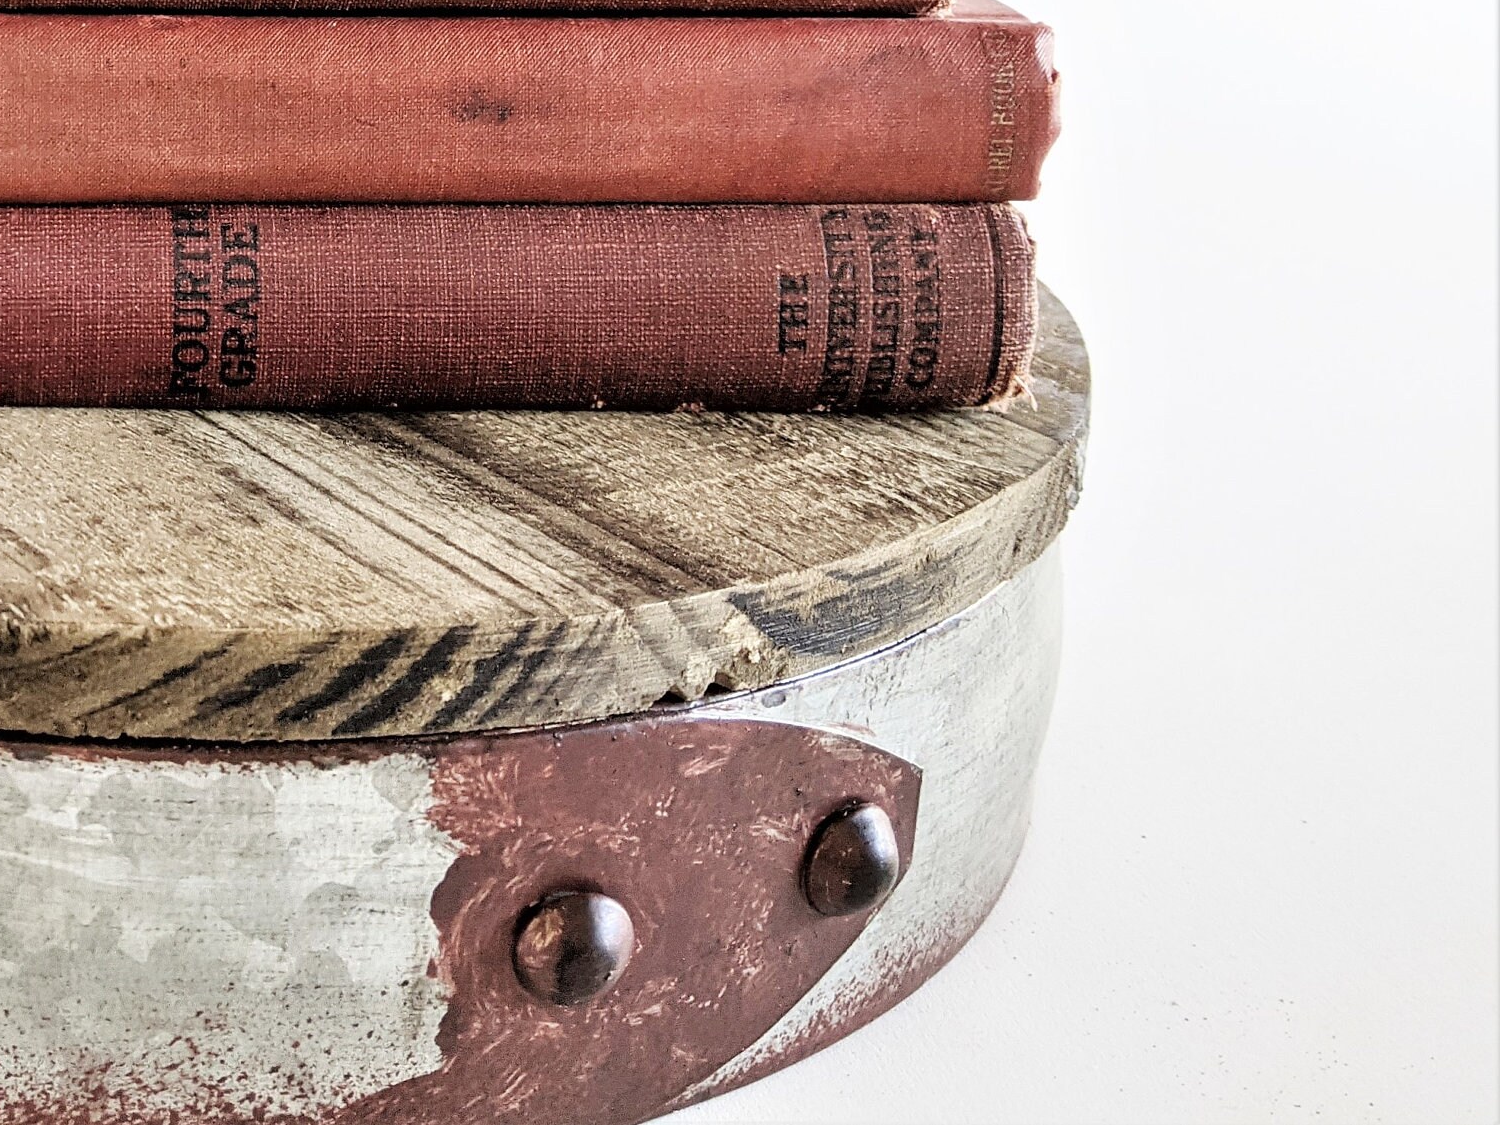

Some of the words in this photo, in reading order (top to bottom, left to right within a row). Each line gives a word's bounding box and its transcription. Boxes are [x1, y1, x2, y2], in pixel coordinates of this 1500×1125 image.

[170, 206, 212, 403] FOURTH
[219, 223, 260, 387] GRADE
[778, 274, 809, 355] THE
[858, 208, 901, 406] UBLISHING
[905, 228, 940, 389] COMPANY
